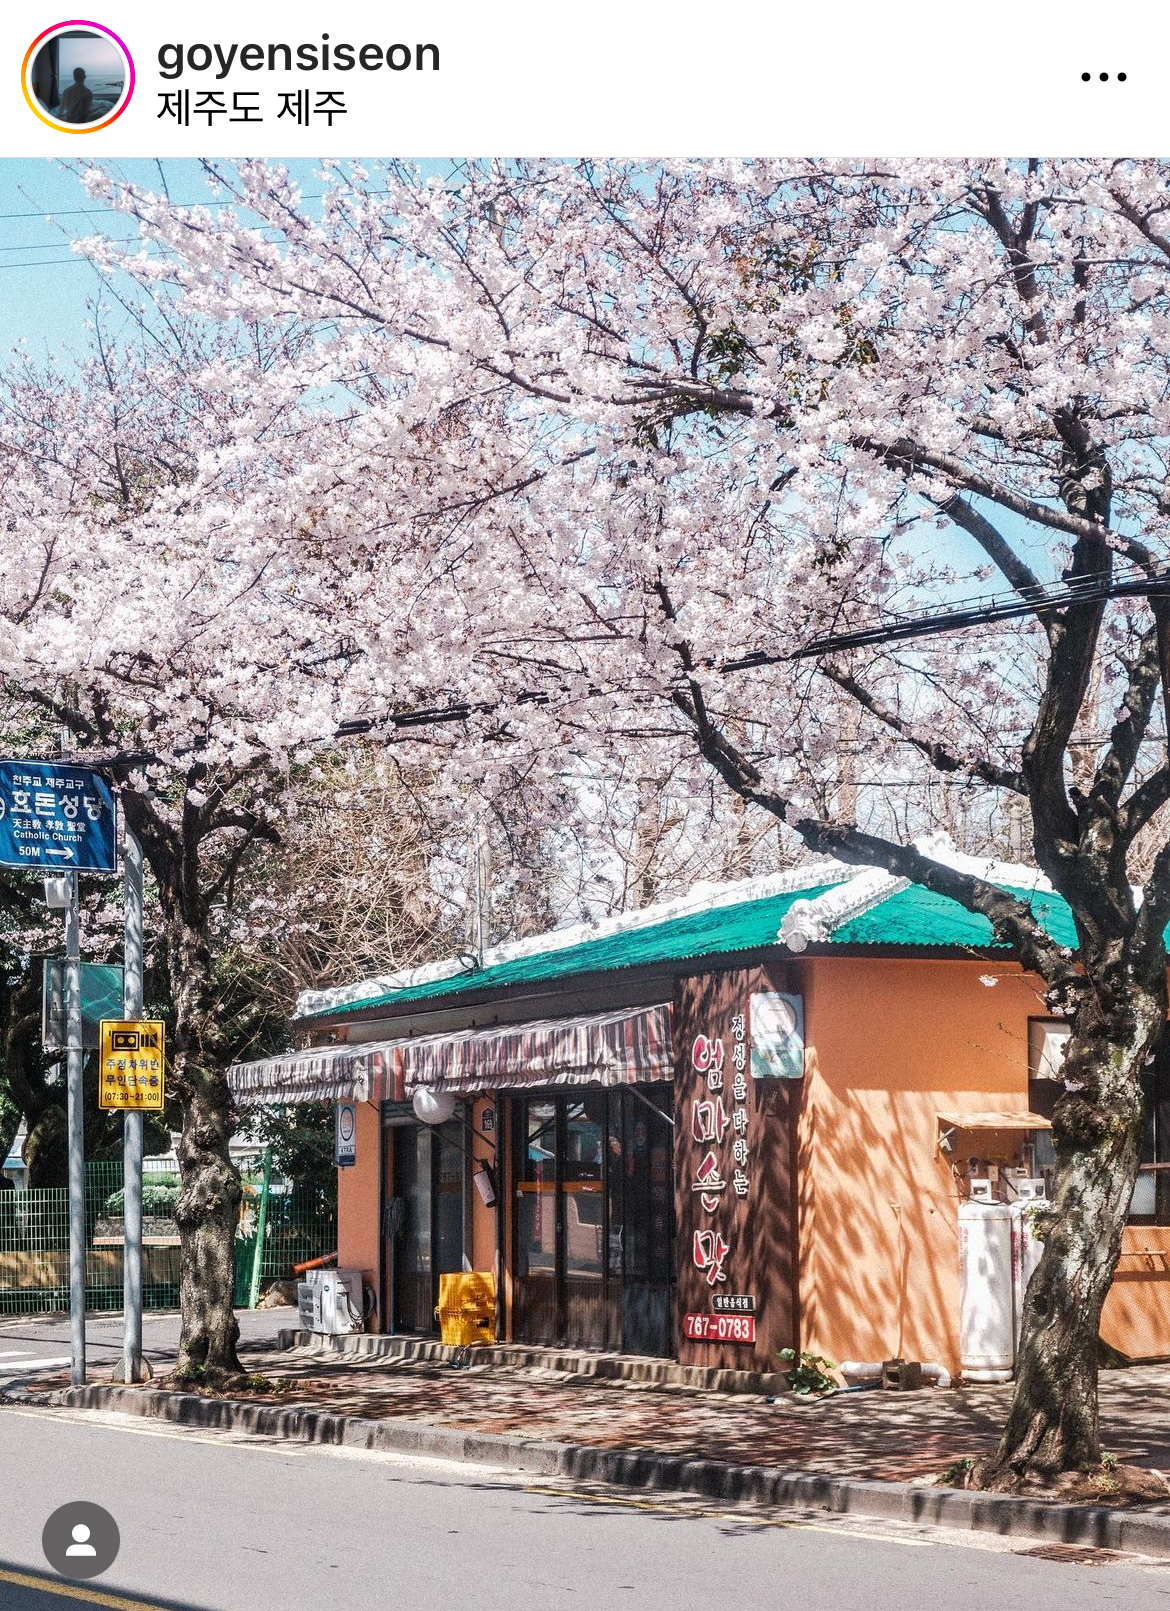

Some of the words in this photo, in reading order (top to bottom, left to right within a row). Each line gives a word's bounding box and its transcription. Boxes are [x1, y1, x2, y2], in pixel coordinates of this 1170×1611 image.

[13, 775, 42, 787] 천주교
[45, 777, 84, 790] 제주교구
[10, 789, 103, 821] 효돈성당
[13, 830, 50, 840] Catholic
[52, 832, 82, 842] Church
[19, 846, 40, 857] 50M
[105, 1074, 159, 1087] 무인단속중
[688, 1315, 750, 1339] 767-0783
